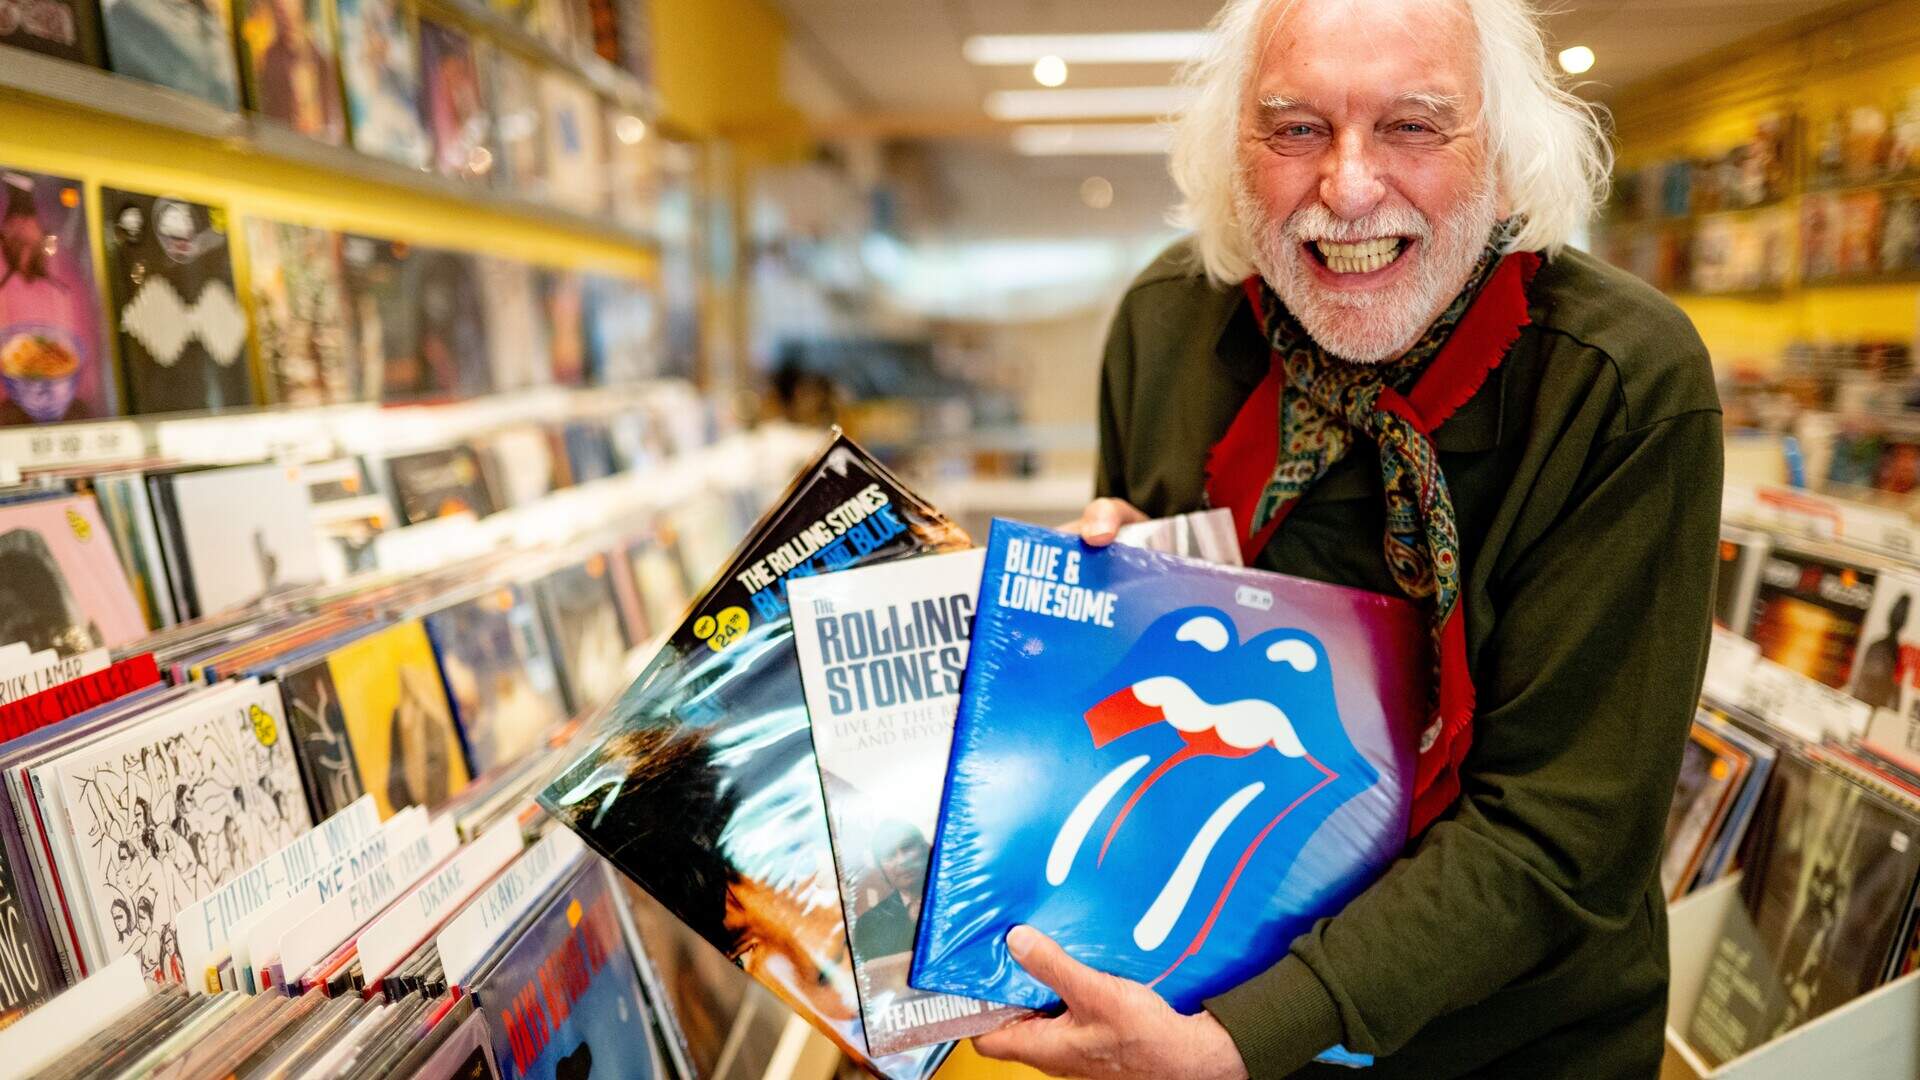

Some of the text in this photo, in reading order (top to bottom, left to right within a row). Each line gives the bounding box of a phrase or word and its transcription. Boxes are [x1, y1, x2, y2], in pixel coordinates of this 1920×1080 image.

[736, 483, 889, 595] THE ROLLING STONES
[1005, 538, 1081, 585] BLUE &
[813, 598, 835, 616] THE
[998, 573, 1118, 628] LONESOME
[816, 594, 976, 666] ROLLING
[825, 647, 966, 716] STONES
[418, 860, 464, 918] DRAKE
[884, 994, 982, 1032] FEATURING
